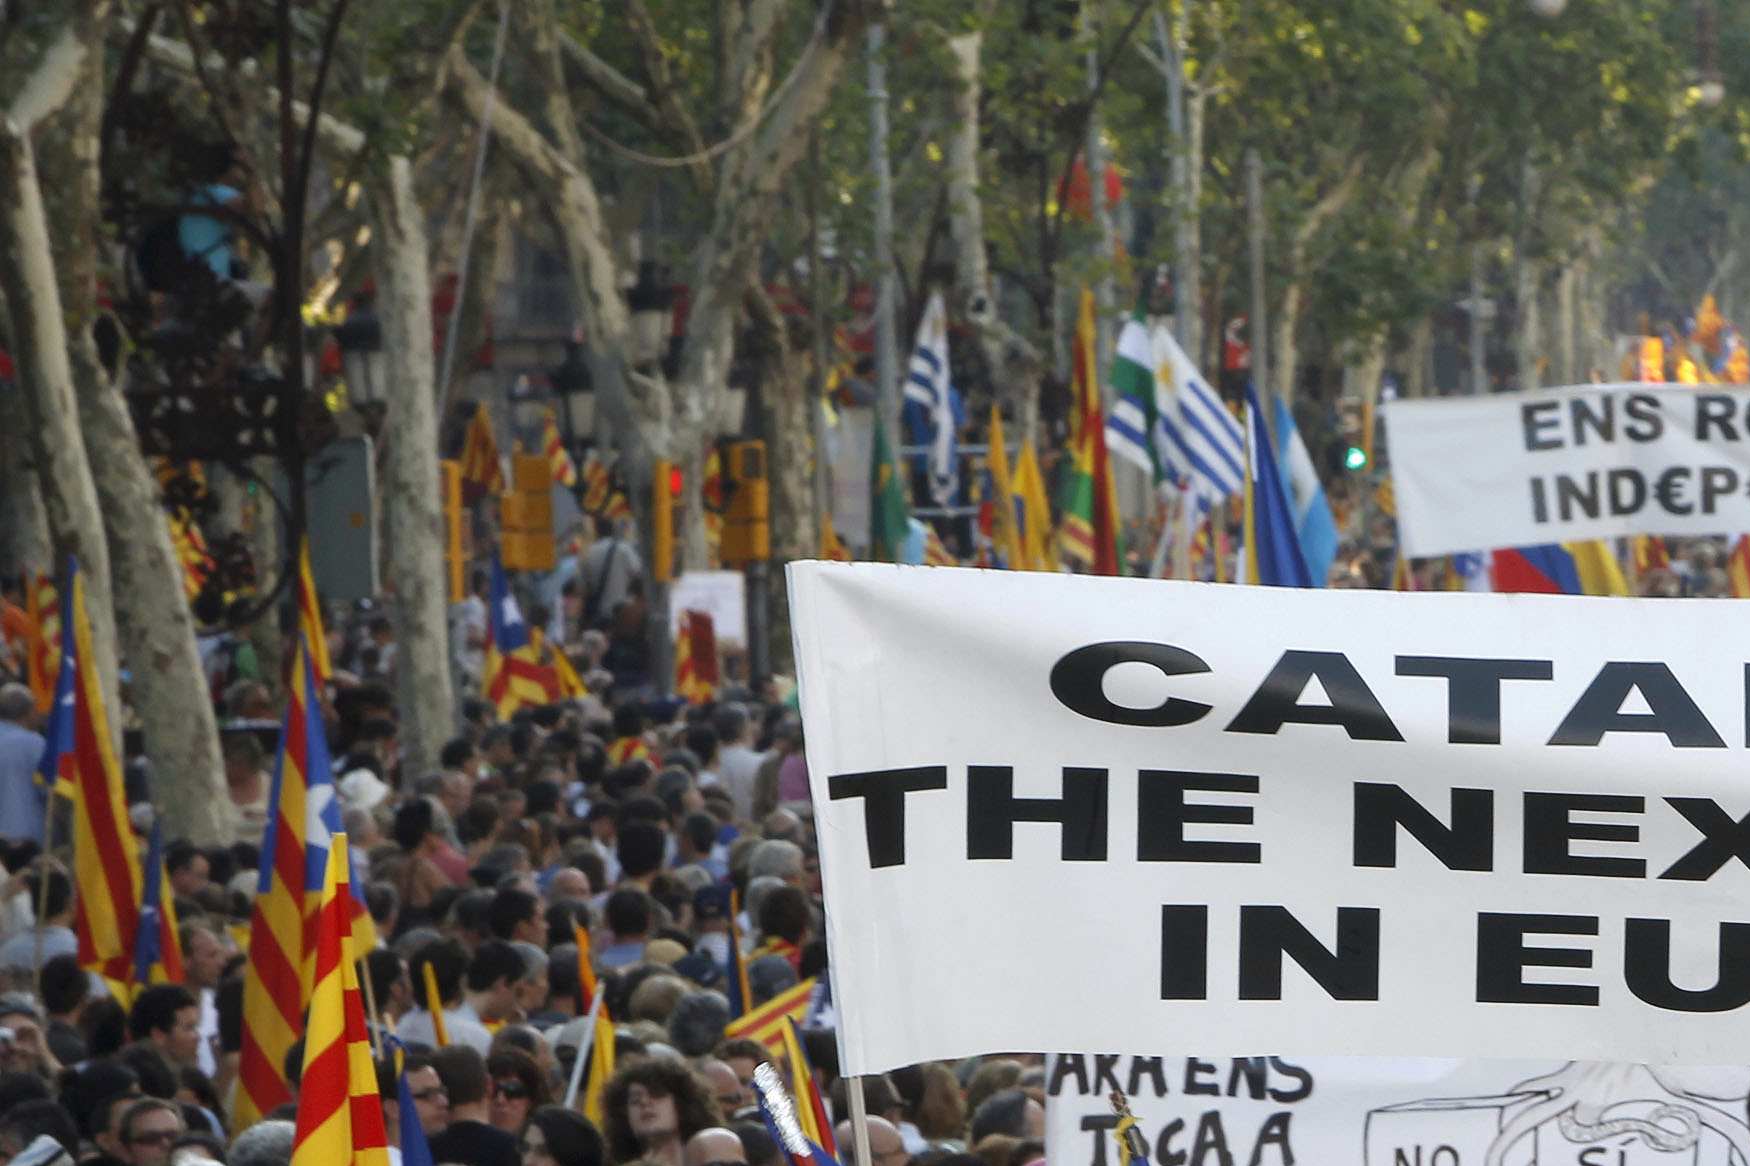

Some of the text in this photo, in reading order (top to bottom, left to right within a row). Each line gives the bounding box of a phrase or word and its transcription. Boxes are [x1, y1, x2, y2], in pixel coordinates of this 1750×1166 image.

[1521, 394, 1664, 453] ENS
[827, 765, 1262, 870] THE
[1160, 904, 1381, 1002] IN
[1182, 1055, 1314, 1103] ENS
